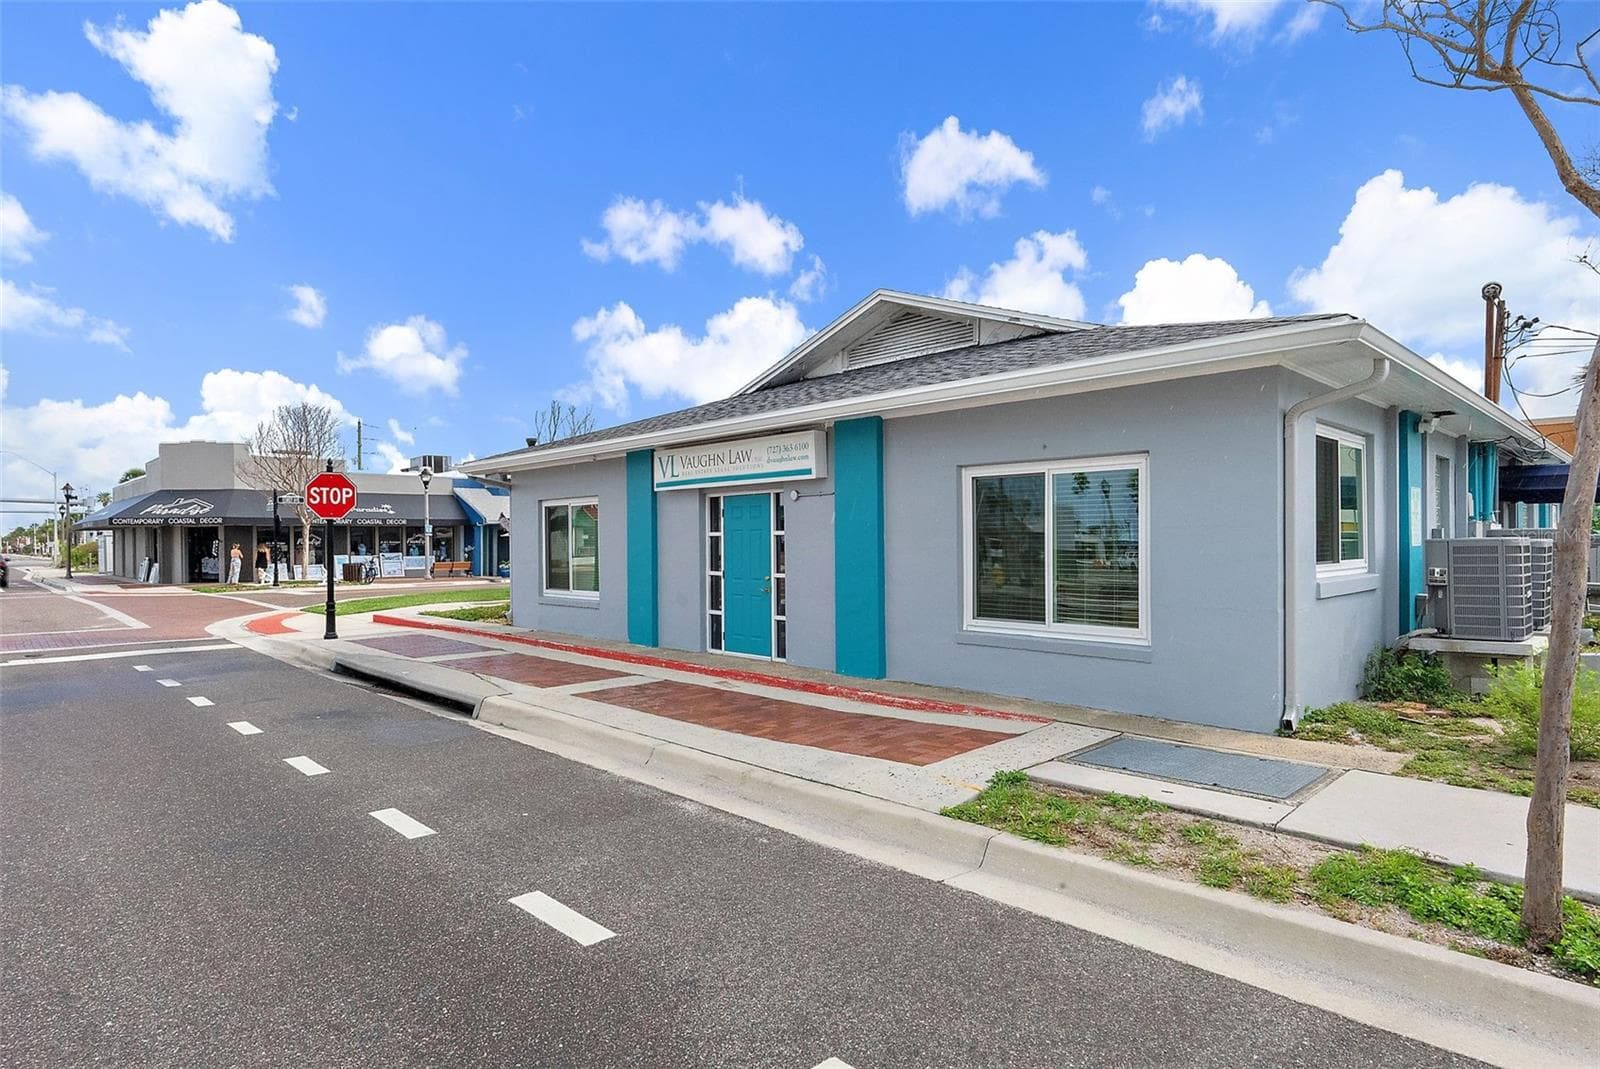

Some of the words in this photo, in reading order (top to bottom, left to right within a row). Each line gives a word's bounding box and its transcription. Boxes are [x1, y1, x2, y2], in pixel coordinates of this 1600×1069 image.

[766, 445, 782, 455] (727)
[657, 454, 680, 479] VL
[309, 487, 353, 505] STOP
